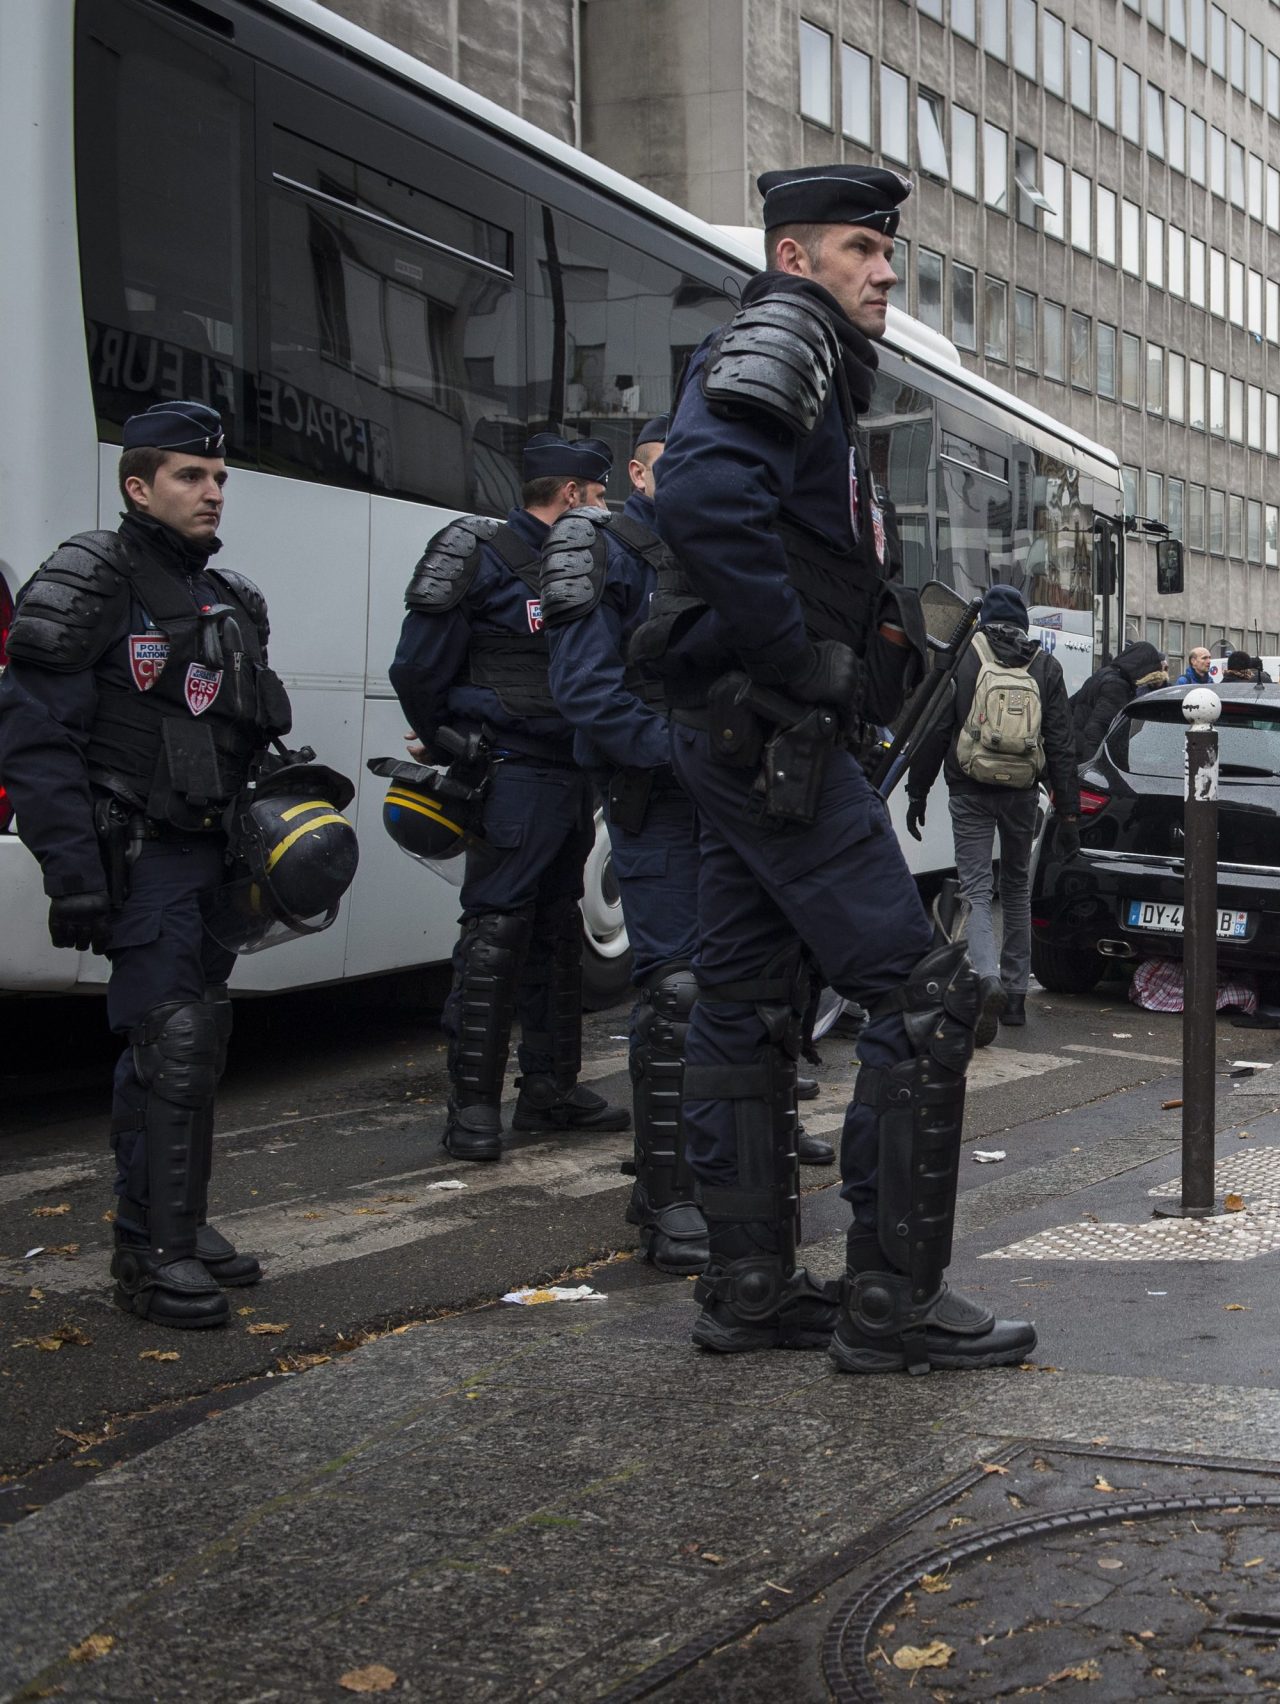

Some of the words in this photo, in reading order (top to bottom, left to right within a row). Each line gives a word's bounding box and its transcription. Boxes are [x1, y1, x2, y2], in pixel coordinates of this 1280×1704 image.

[140, 644, 171, 652] POLIC
[190, 679, 214, 694] CRS
[1234, 924, 1245, 934] 94
